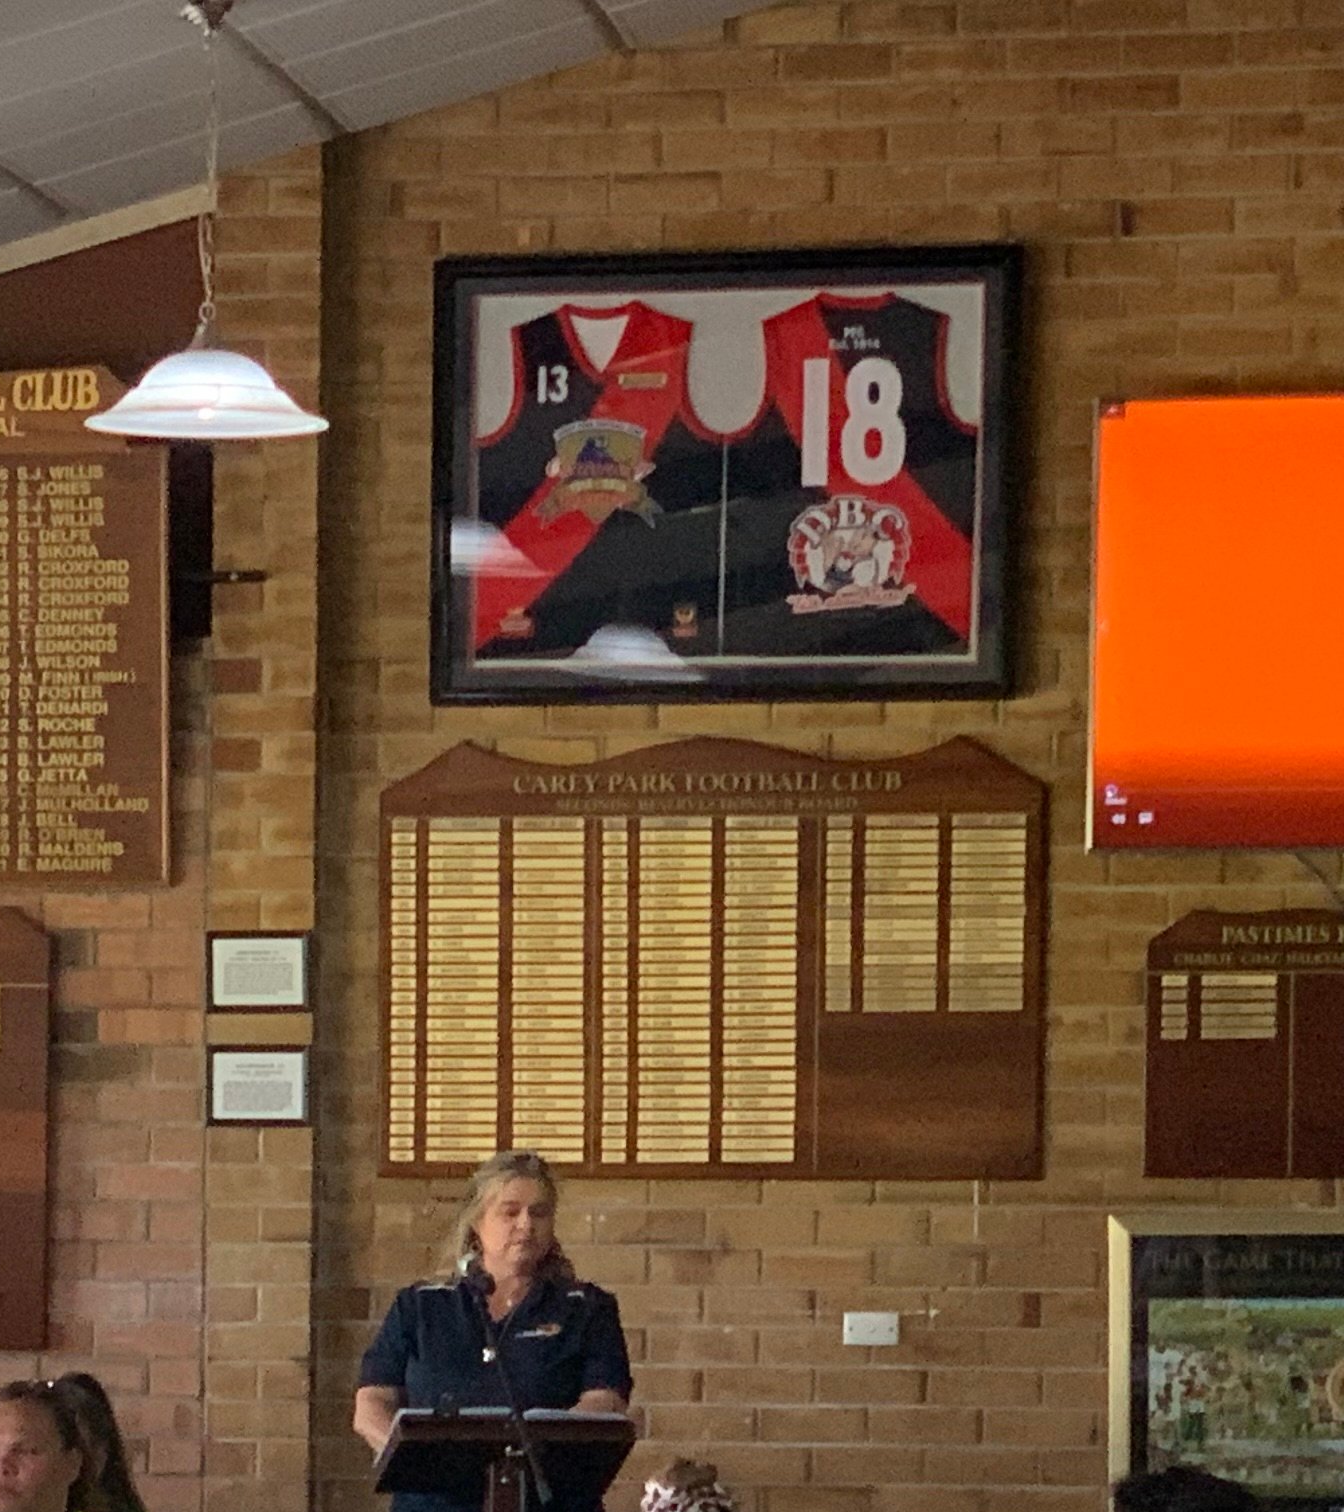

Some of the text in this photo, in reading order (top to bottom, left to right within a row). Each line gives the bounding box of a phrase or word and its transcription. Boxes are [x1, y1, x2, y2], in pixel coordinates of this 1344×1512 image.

[13, 369, 100, 411] CLUB
[537, 365, 569, 404] 13
[801, 356, 907, 488] 18
[49, 465, 103, 480] WILLIS
[37, 482, 91, 496] JONES
[50, 497, 104, 511] WILLIS
[38, 560, 129, 574] CROXFORD
[38, 576, 129, 590] CROXFORD
[38, 592, 129, 605] CROXFORD
[38, 607, 104, 622] DENNEY
[35, 623, 117, 637] EDMONDS
[35, 639, 117, 653] EDMONDS
[36, 655, 101, 668] WILSON
[42, 671, 80, 684] FINN
[38, 686, 103, 699] FOSTER
[36, 701, 108, 715] DENARDI
[38, 718, 96, 732] ROCHE
[38, 736, 105, 749] LAWLER
[38, 753, 105, 767] LAWLER
[38, 769, 88, 781] JETTA
[513, 771, 903, 794] CAREY PARK FOOTBALL CLUB
[36, 798, 149, 812] MULHOLLAND
[36, 813, 78, 826] BELL
[39, 828, 105, 841] O'BRIEN
[36, 857, 112, 872] MAGUIRE
[1221, 924, 1330, 944] PASTIMES
